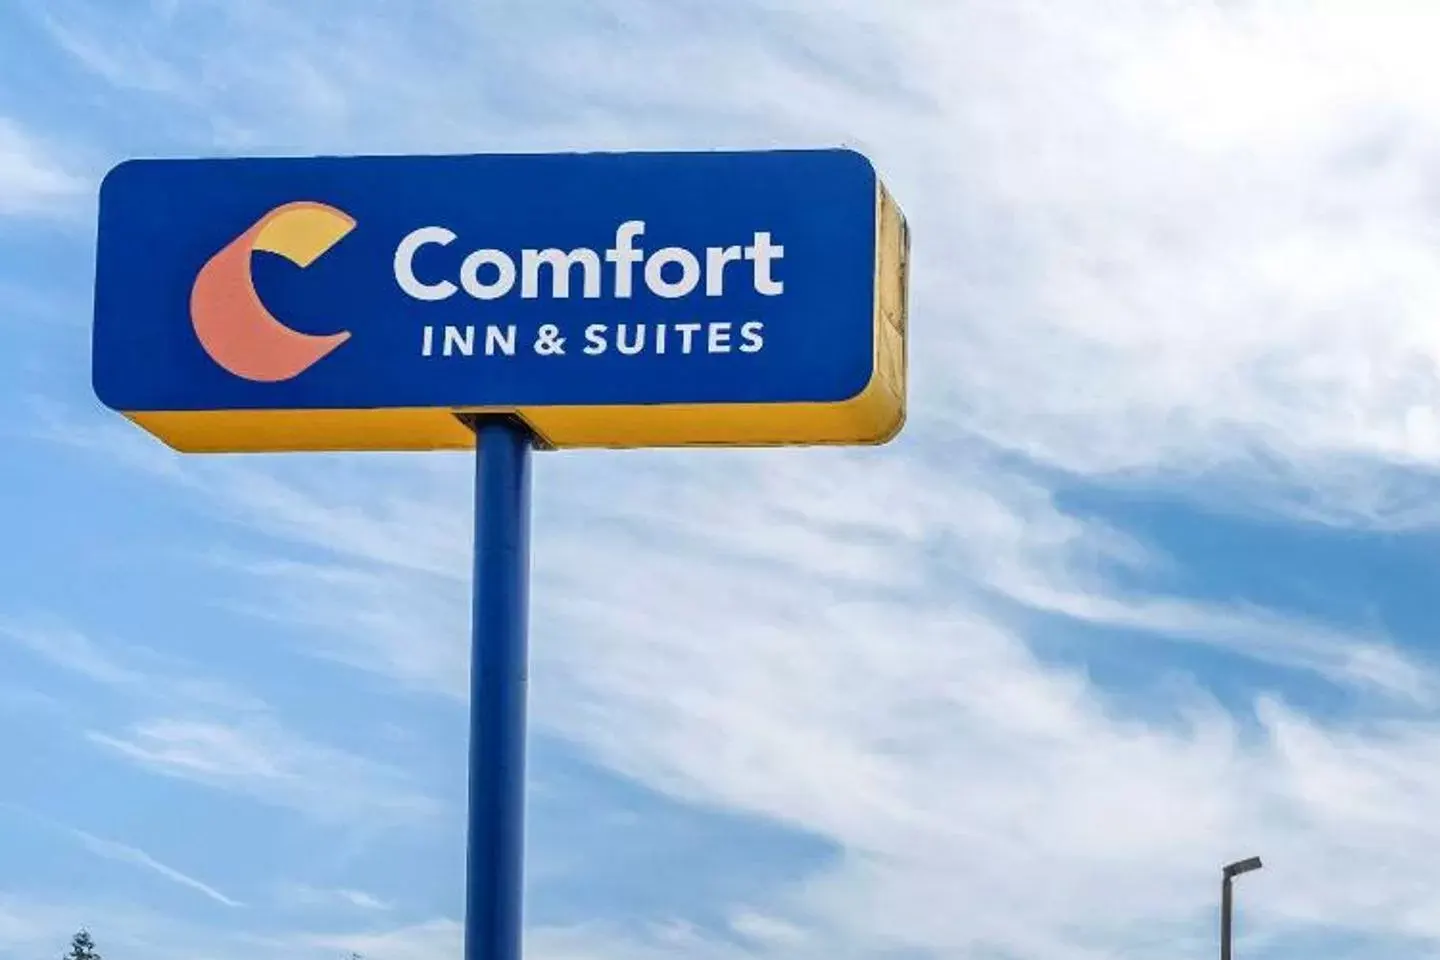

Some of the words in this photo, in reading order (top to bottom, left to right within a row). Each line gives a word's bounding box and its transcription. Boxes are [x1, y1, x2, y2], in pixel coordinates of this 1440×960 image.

[393, 220, 785, 301] Comfort
[422, 325, 517, 356] INN
[533, 324, 567, 356] &
[583, 321, 764, 355] SUITES
